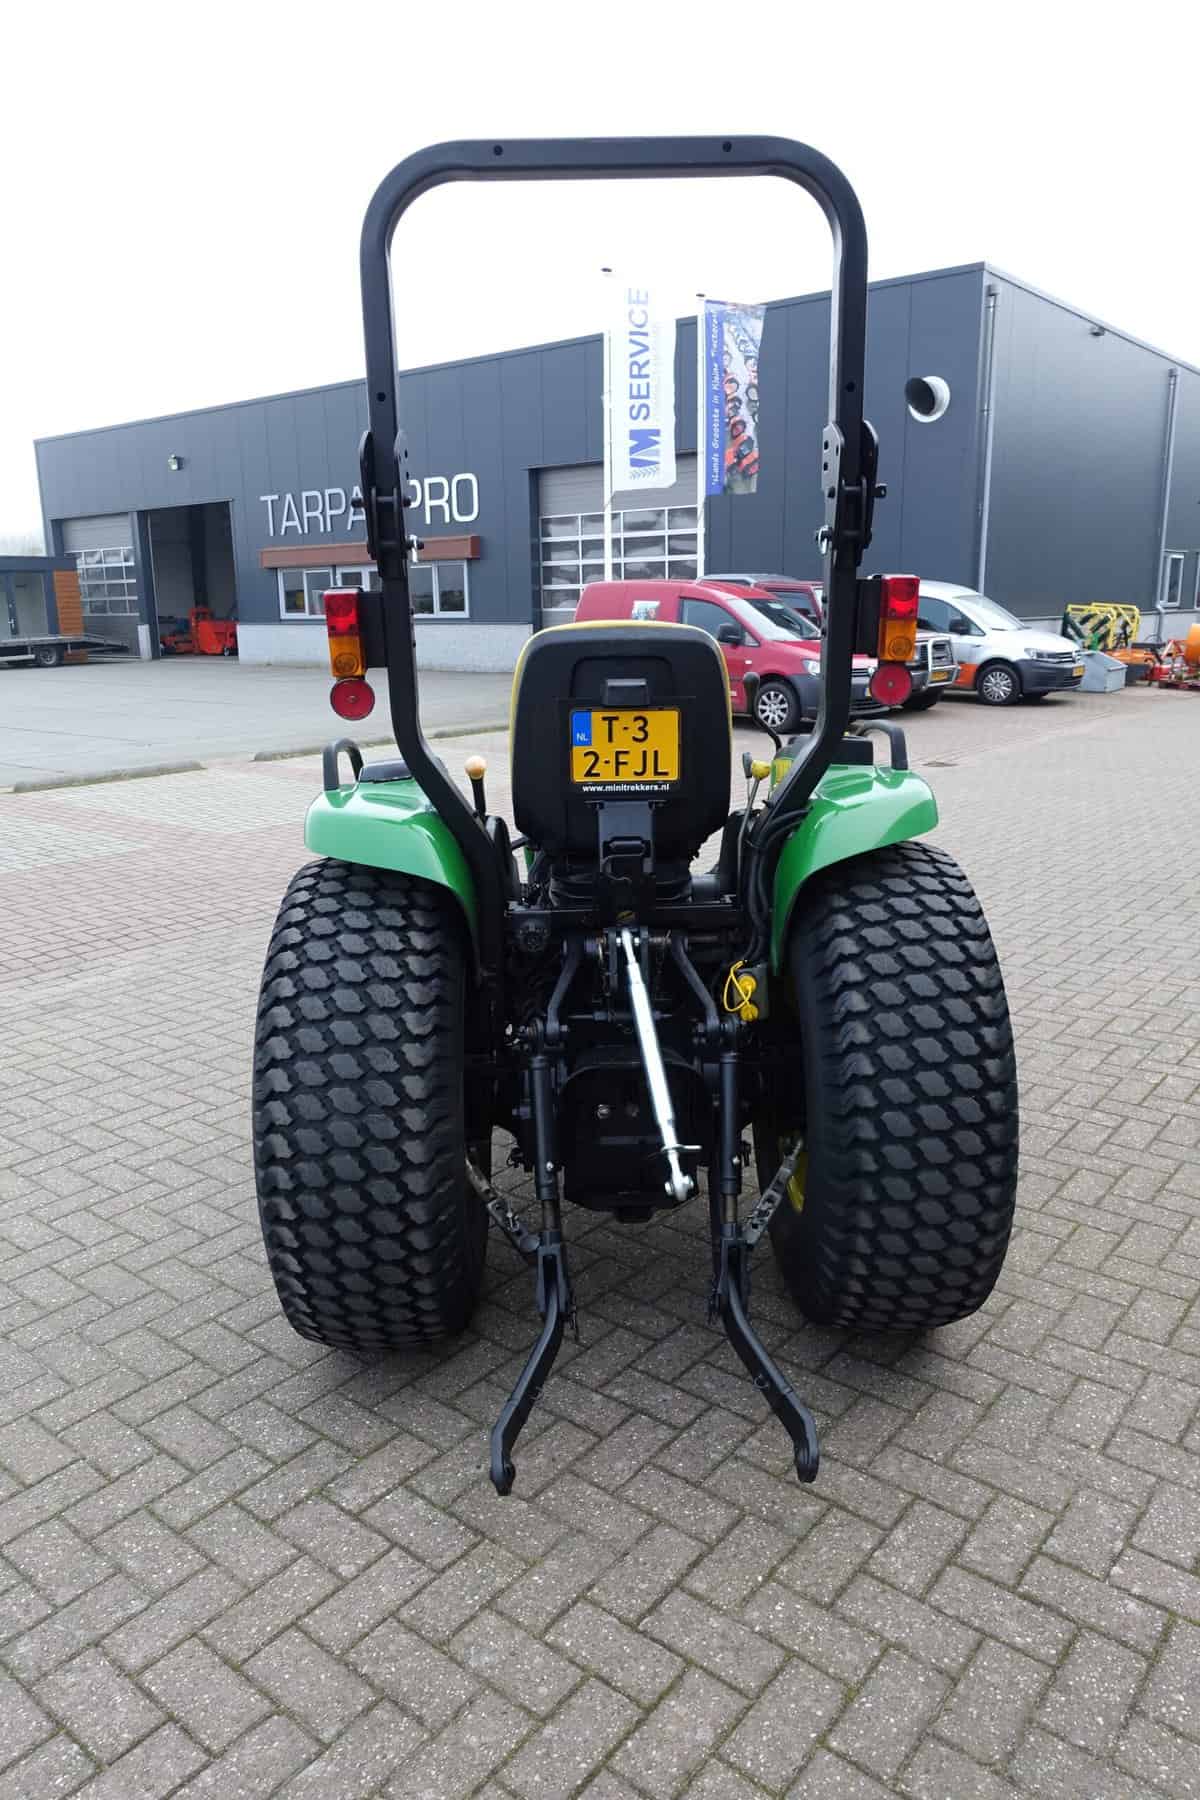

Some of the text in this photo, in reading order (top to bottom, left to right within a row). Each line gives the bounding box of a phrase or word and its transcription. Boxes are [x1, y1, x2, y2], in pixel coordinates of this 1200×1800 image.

[628, 288, 650, 421] SERVICE
[576, 732, 588, 742] NL
[601, 716, 649, 743] T-3
[583, 750, 670, 778] 2-FJL
